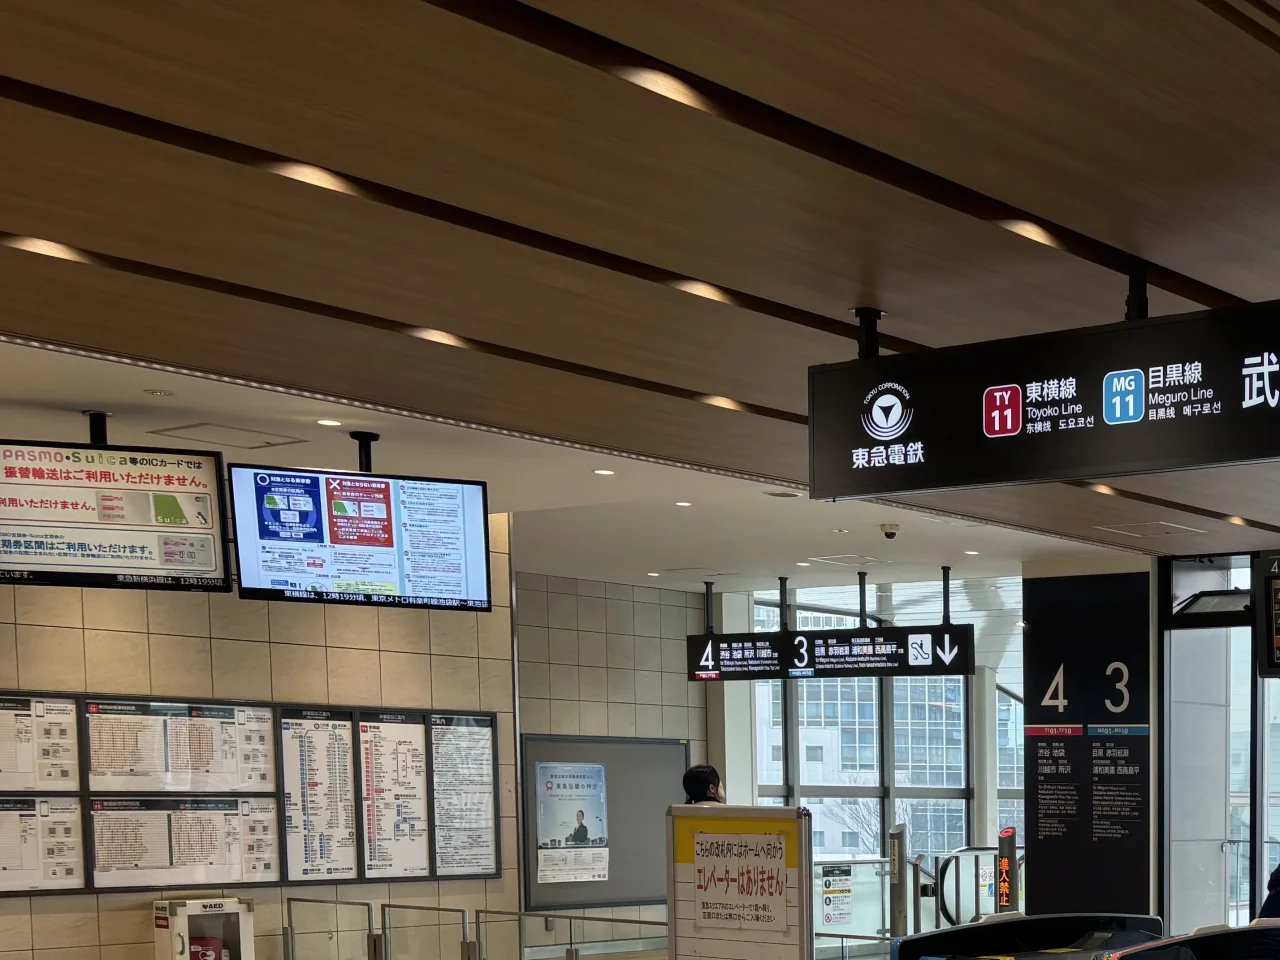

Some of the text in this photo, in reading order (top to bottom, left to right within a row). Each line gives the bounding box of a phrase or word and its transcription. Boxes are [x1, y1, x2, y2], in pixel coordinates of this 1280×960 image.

[1112, 376, 1135, 392] MG
[1148, 361, 1202, 389] 目黒線
[864, 382, 910, 404] TOKYU CORPORATION
[993, 391, 1011, 406] TY
[1025, 377, 1077, 403] 東横線
[1148, 387, 1214, 407] Meguro Line
[1062, 403, 1083, 415] Line
[1111, 395, 1135, 418] 11
[1182, 401, 1222, 417] 메구로선
[991, 408, 1013, 431] 11
[1026, 421, 1052, 434] 东横线
[1058, 416, 1095, 430] 도요코선
[852, 441, 925, 469] 東急電鉄
[1271, 560, 1279, 574] 4
[700, 640, 714, 669] 4
[794, 636, 808, 667] 3
[1040, 662, 1068, 712] 4
[1104, 661, 1130, 713] 3
[696, 840, 783, 860] こちらの改札内にはホームへ向かう
[697, 864, 783, 896] エレベーターはありません
[999, 857, 1010, 906] 進入禁止
